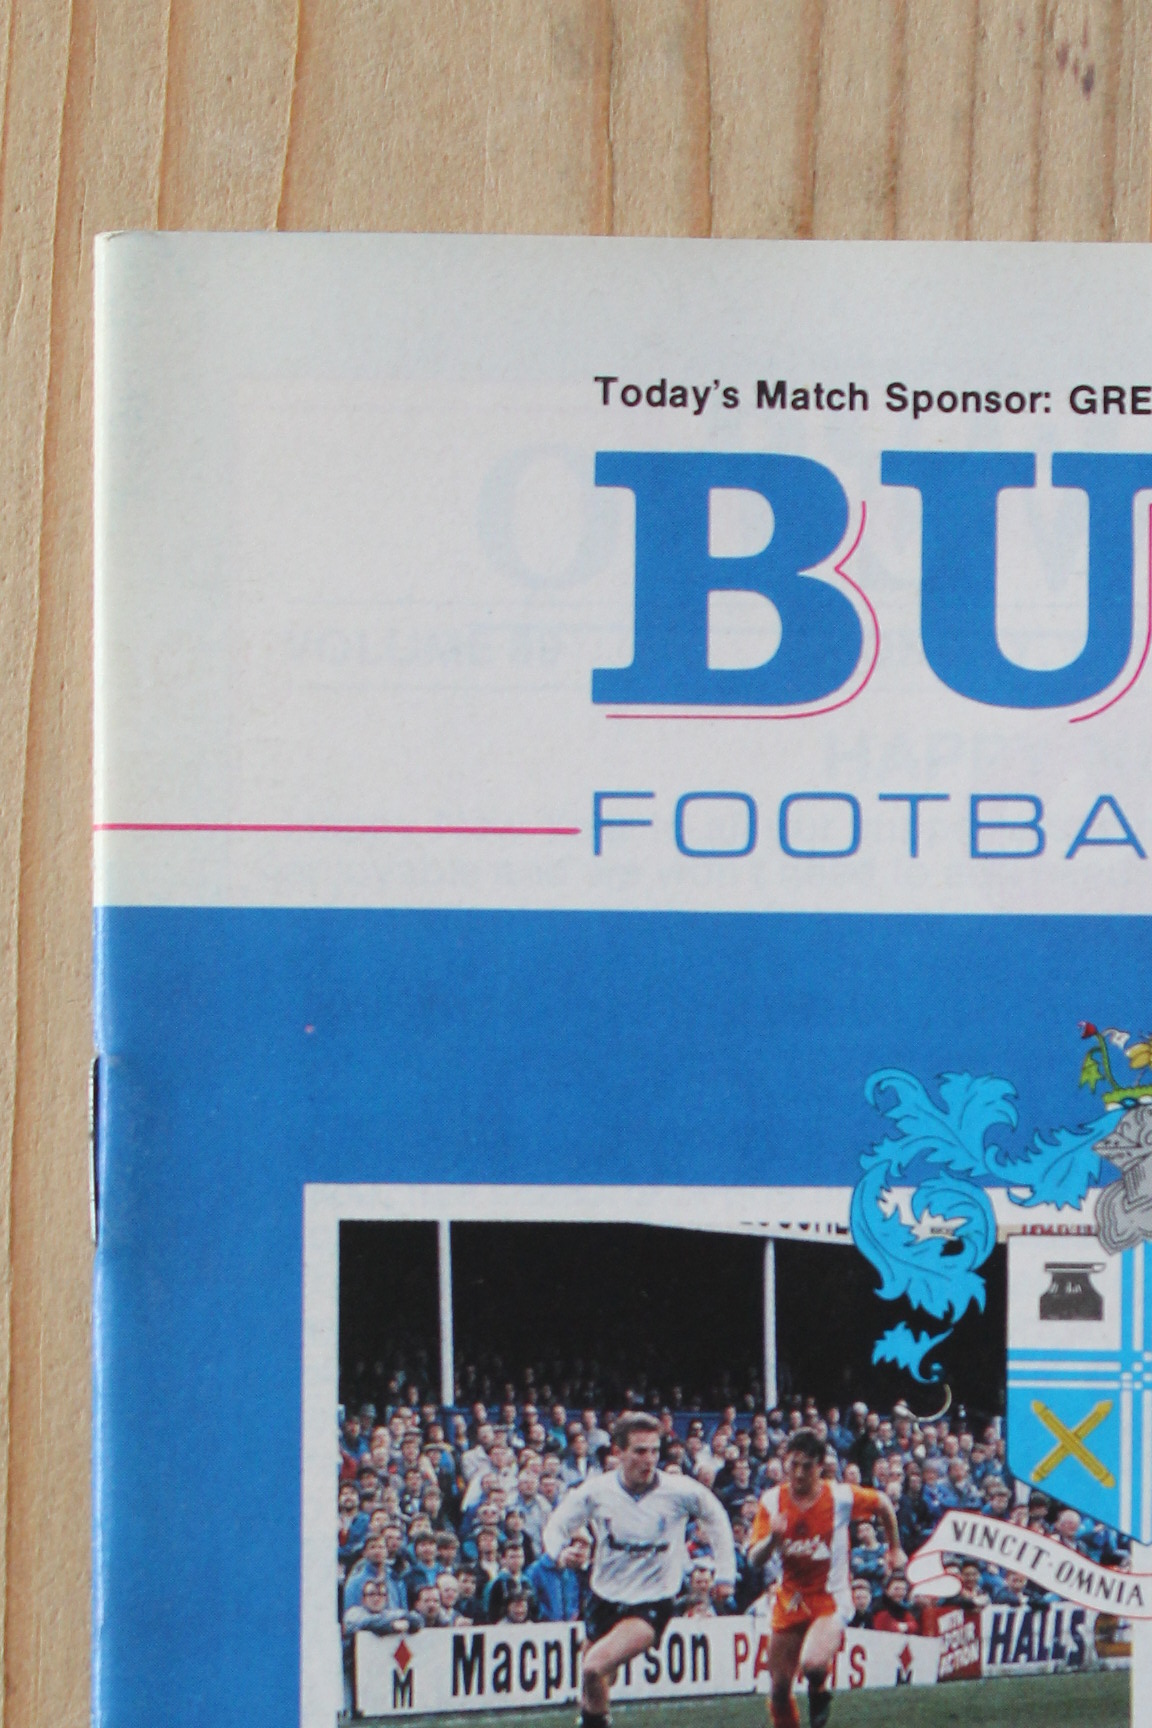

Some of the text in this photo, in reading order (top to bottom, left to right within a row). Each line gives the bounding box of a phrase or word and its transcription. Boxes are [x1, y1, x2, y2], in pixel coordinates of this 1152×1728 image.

[594, 376, 739, 415] Today's
[756, 379, 869, 412] Match
[885, 382, 1051, 420] Sponsor:
[951, 1520, 1051, 1569] VINCIT
[1055, 1560, 1145, 1607] OMNIA
[452, 1626, 867, 1700] Macphrson PATS
[987, 1607, 1087, 1667] HALLS
